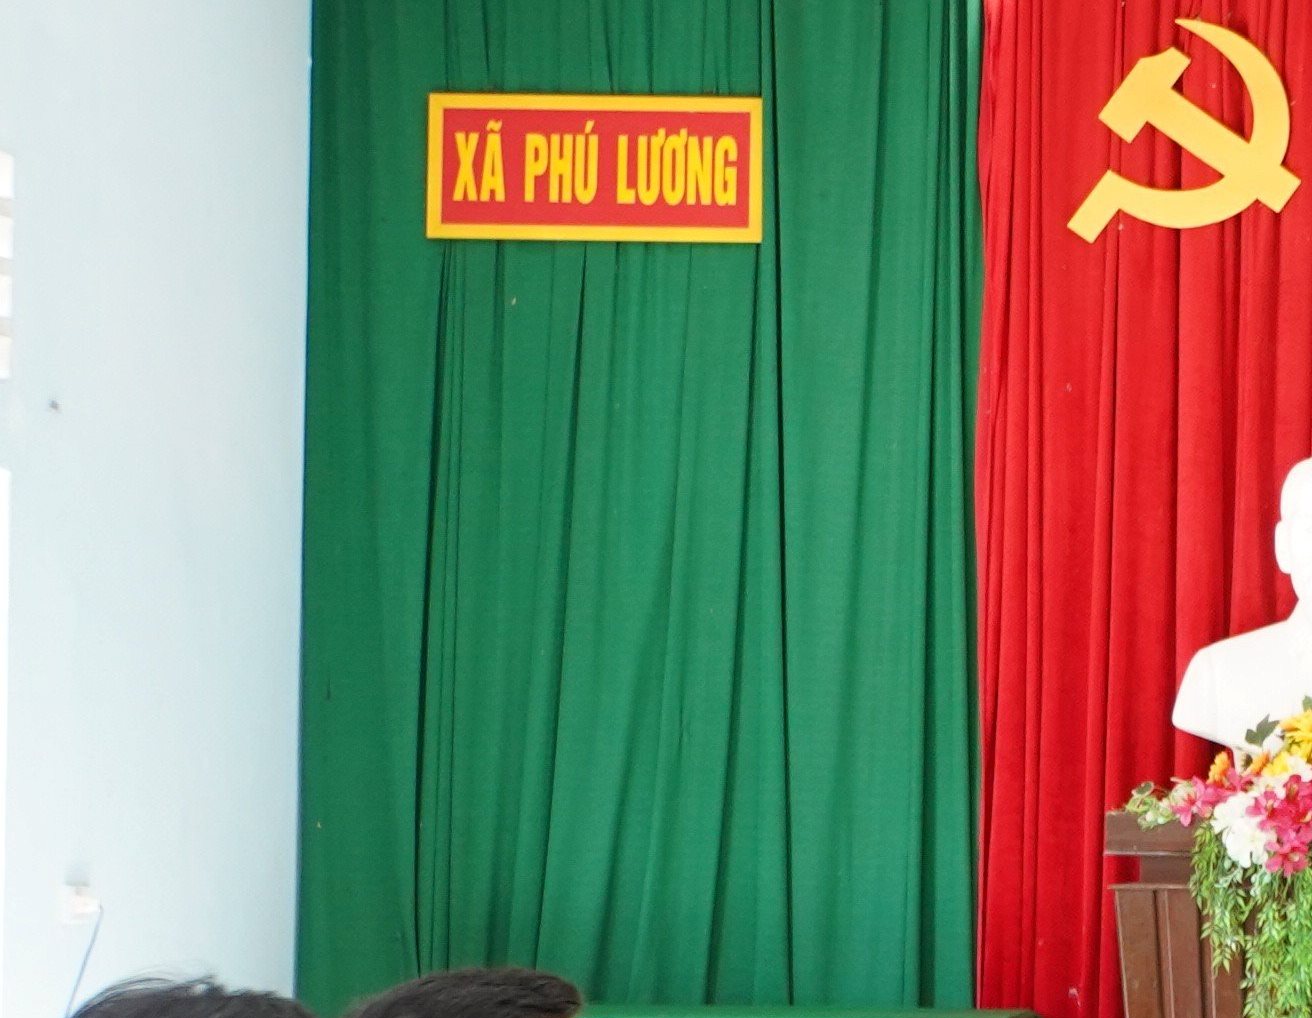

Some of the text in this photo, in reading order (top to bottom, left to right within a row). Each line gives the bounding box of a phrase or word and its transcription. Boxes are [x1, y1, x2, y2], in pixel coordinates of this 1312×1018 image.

[453, 119, 739, 207] XÃ PHÚ LƯƠNG
